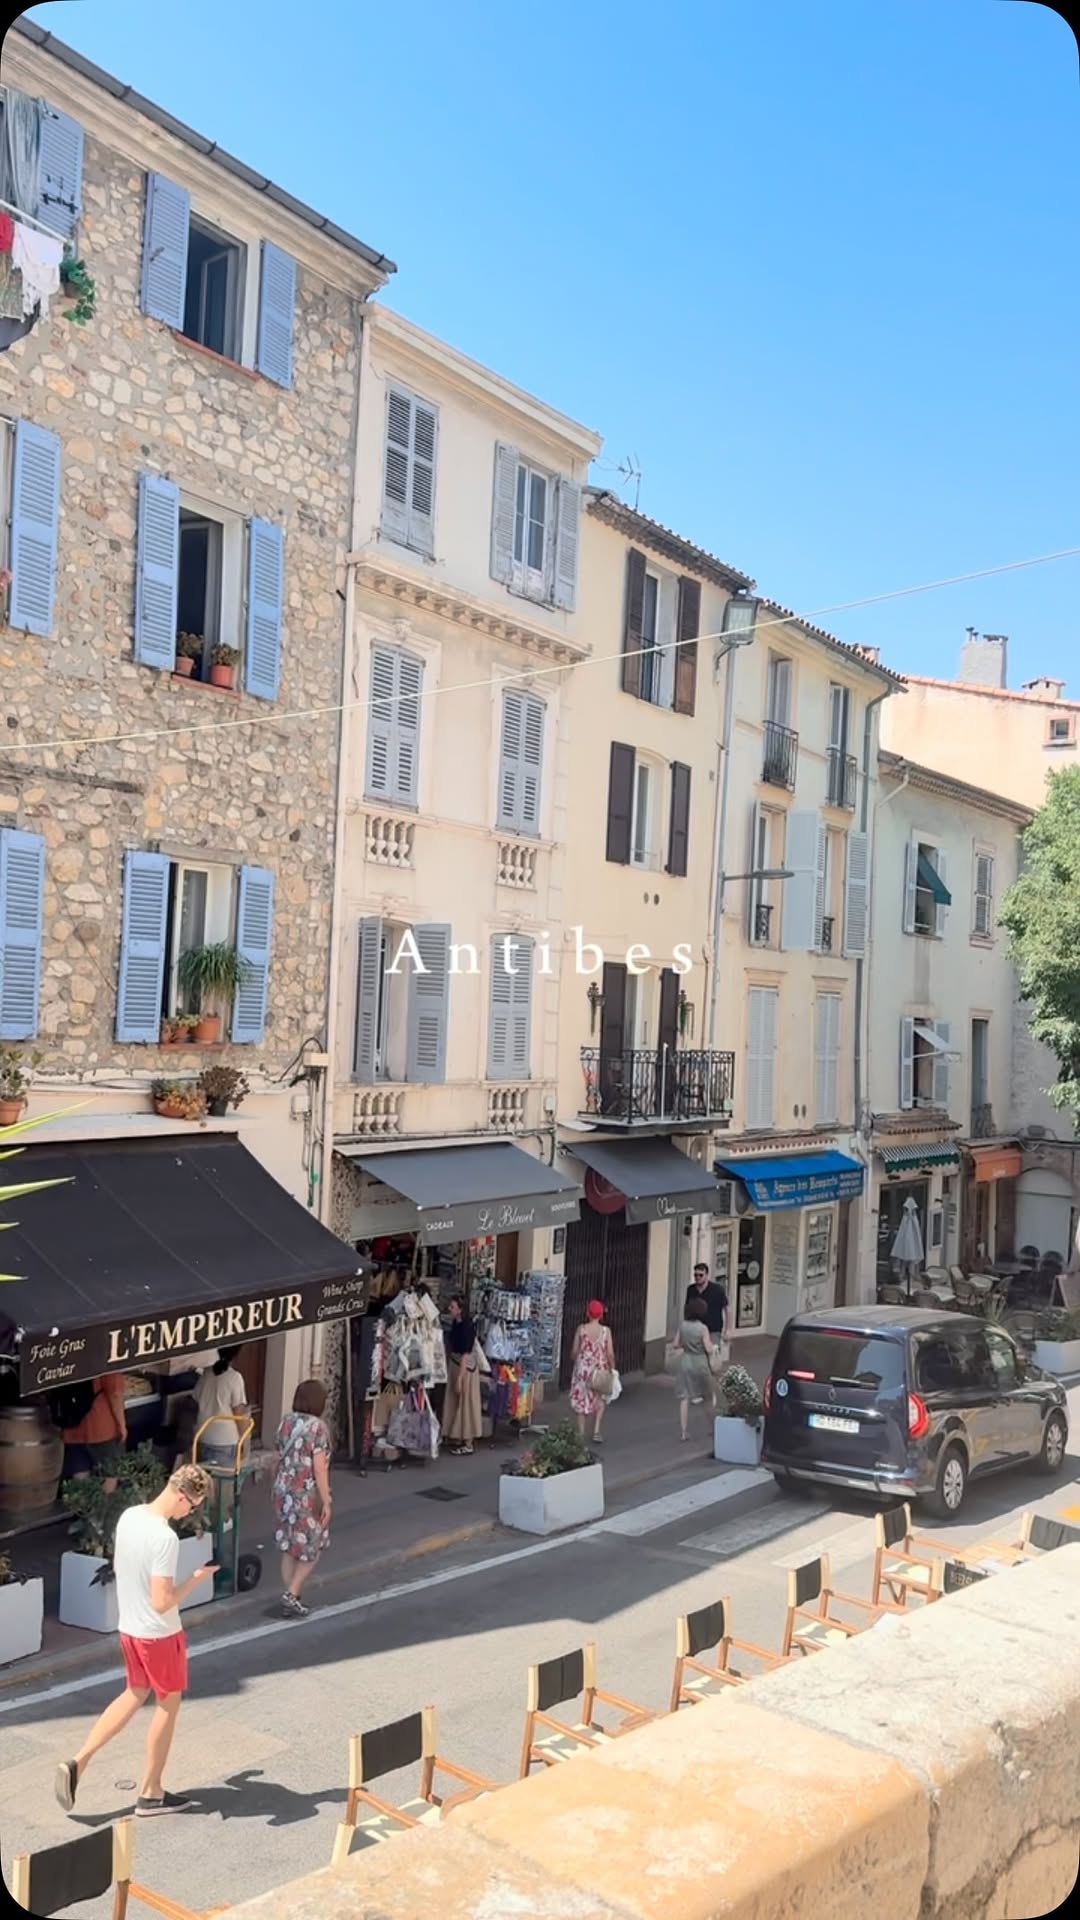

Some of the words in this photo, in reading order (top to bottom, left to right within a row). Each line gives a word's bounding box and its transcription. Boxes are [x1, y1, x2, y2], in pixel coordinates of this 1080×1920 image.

[426, 1220, 455, 1231] CADEAUX
[477, 1207, 494, 1231] Le
[107, 1293, 303, 1363] L'EMPEREUR
[30, 1342, 57, 1363] Foie
[59, 1338, 86, 1359] Gras
[37, 1363, 76, 1384] Caviar
